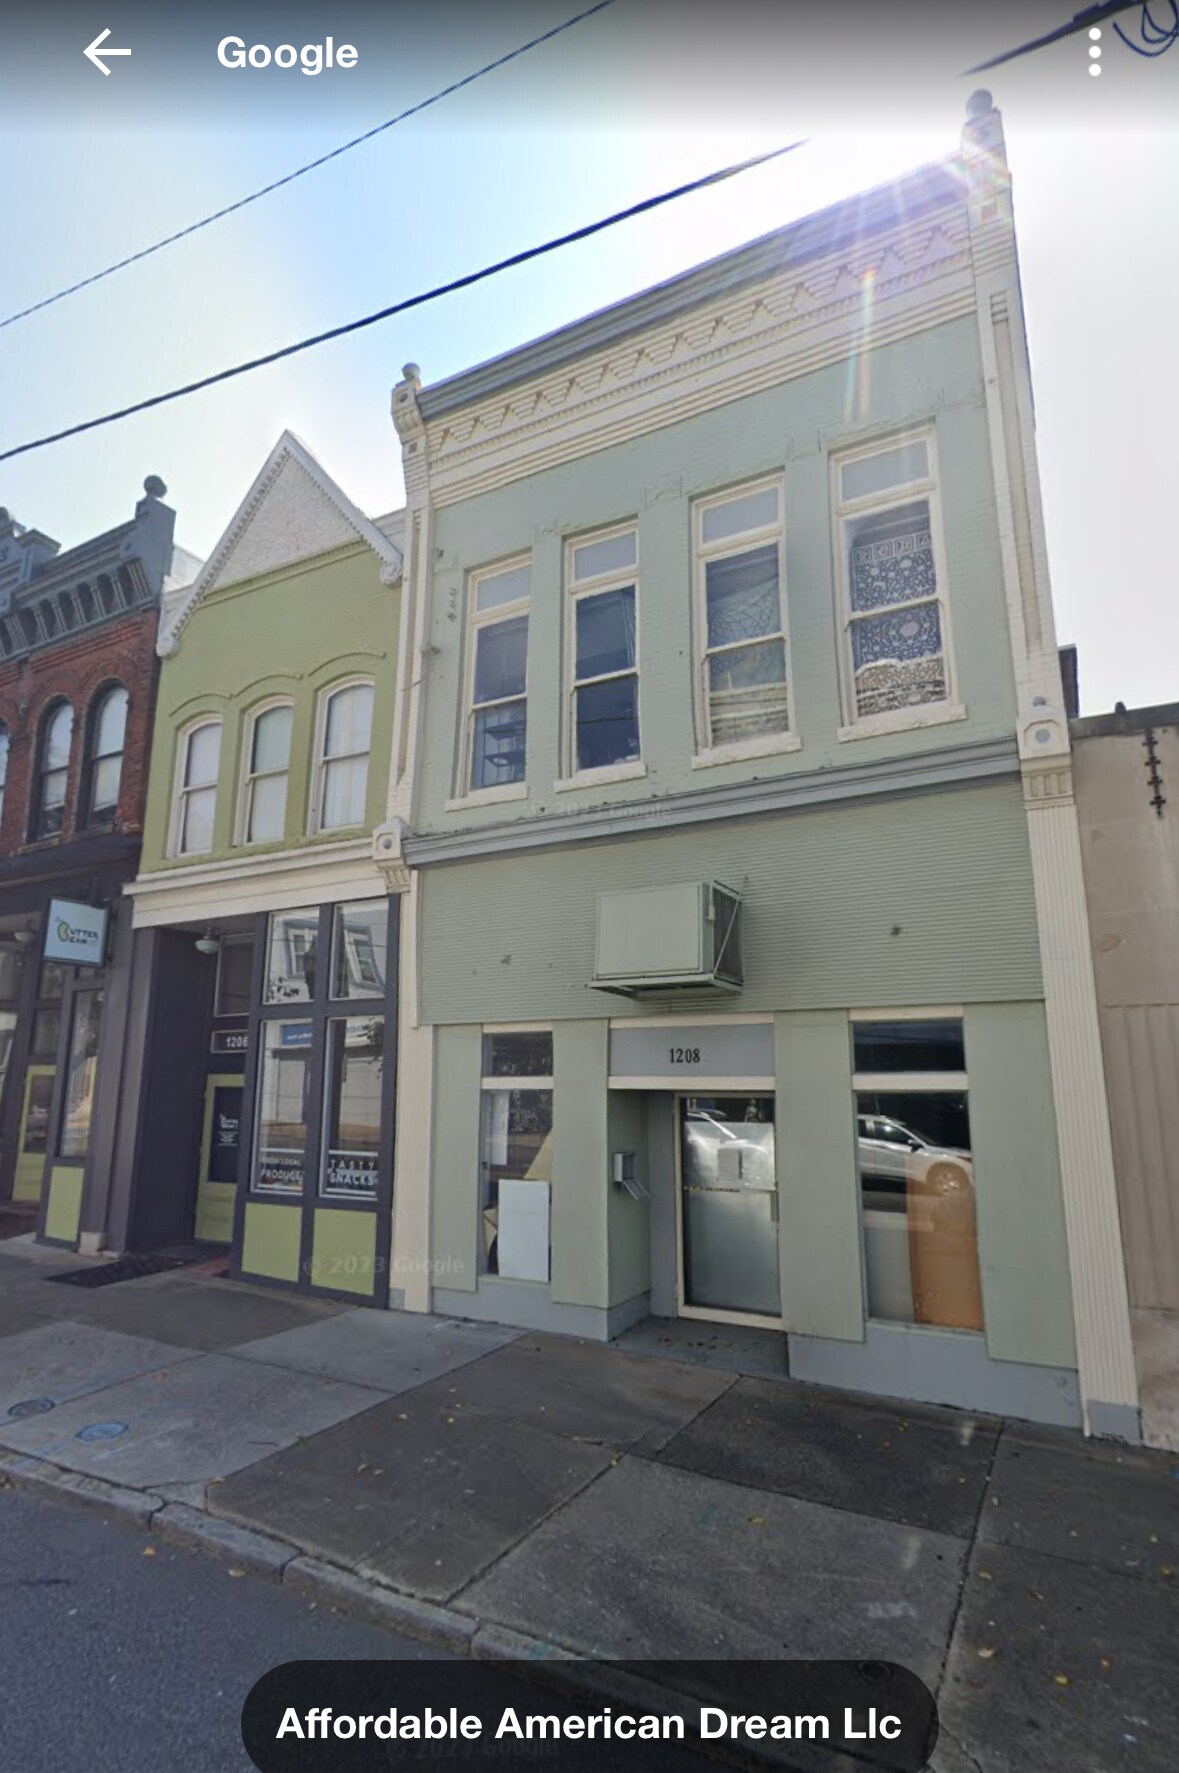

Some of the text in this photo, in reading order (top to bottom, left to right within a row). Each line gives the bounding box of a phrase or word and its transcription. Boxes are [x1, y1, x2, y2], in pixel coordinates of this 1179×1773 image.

[670, 1047, 701, 1063] 1208
[330, 1159, 375, 1171] TASTY
[260, 1169, 302, 1182] PRODUCE
[329, 1173, 374, 1186] SNACKS
